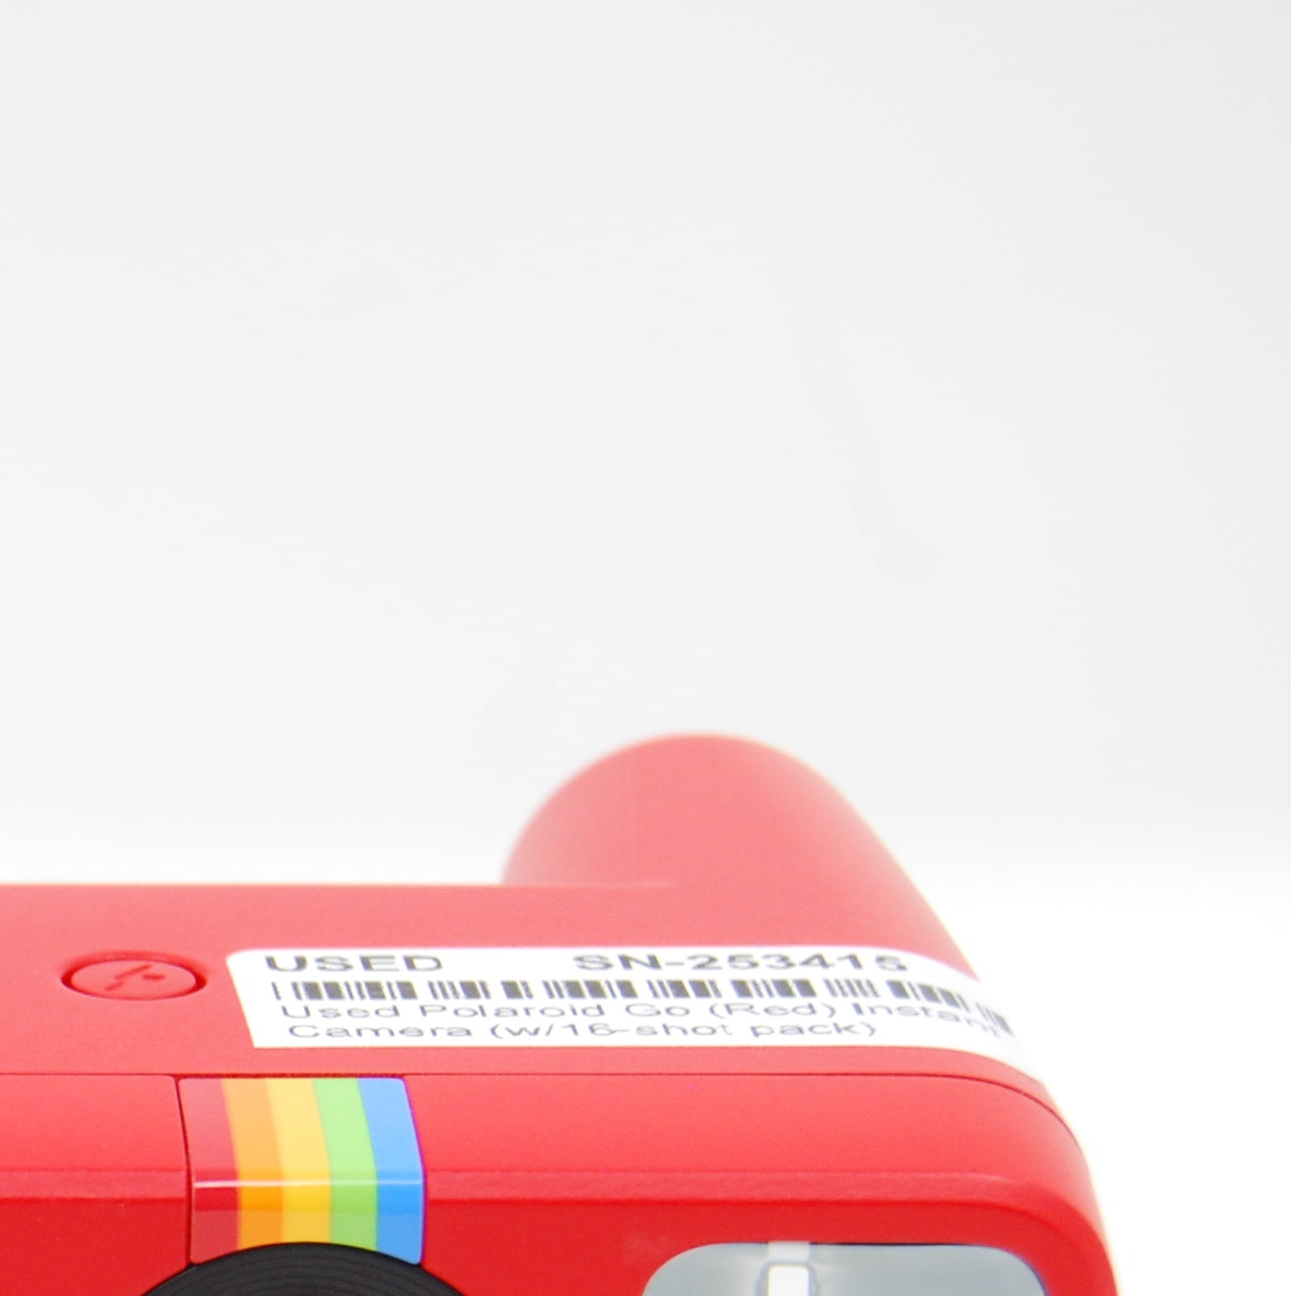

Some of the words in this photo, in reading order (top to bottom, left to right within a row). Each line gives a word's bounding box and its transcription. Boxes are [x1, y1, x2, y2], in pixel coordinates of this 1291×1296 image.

[265, 954, 444, 972] USED
[572, 952, 909, 972] SN-253415
[280, 1003, 401, 1019] Used
[418, 1003, 606, 1018] Polaroid
[624, 1002, 692, 1017] Go
[708, 1002, 837, 1019] (Red)
[288, 1023, 473, 1039] Camera
[489, 1021, 732, 1039] (w/16-shot
[750, 1021, 877, 1039] pack)
